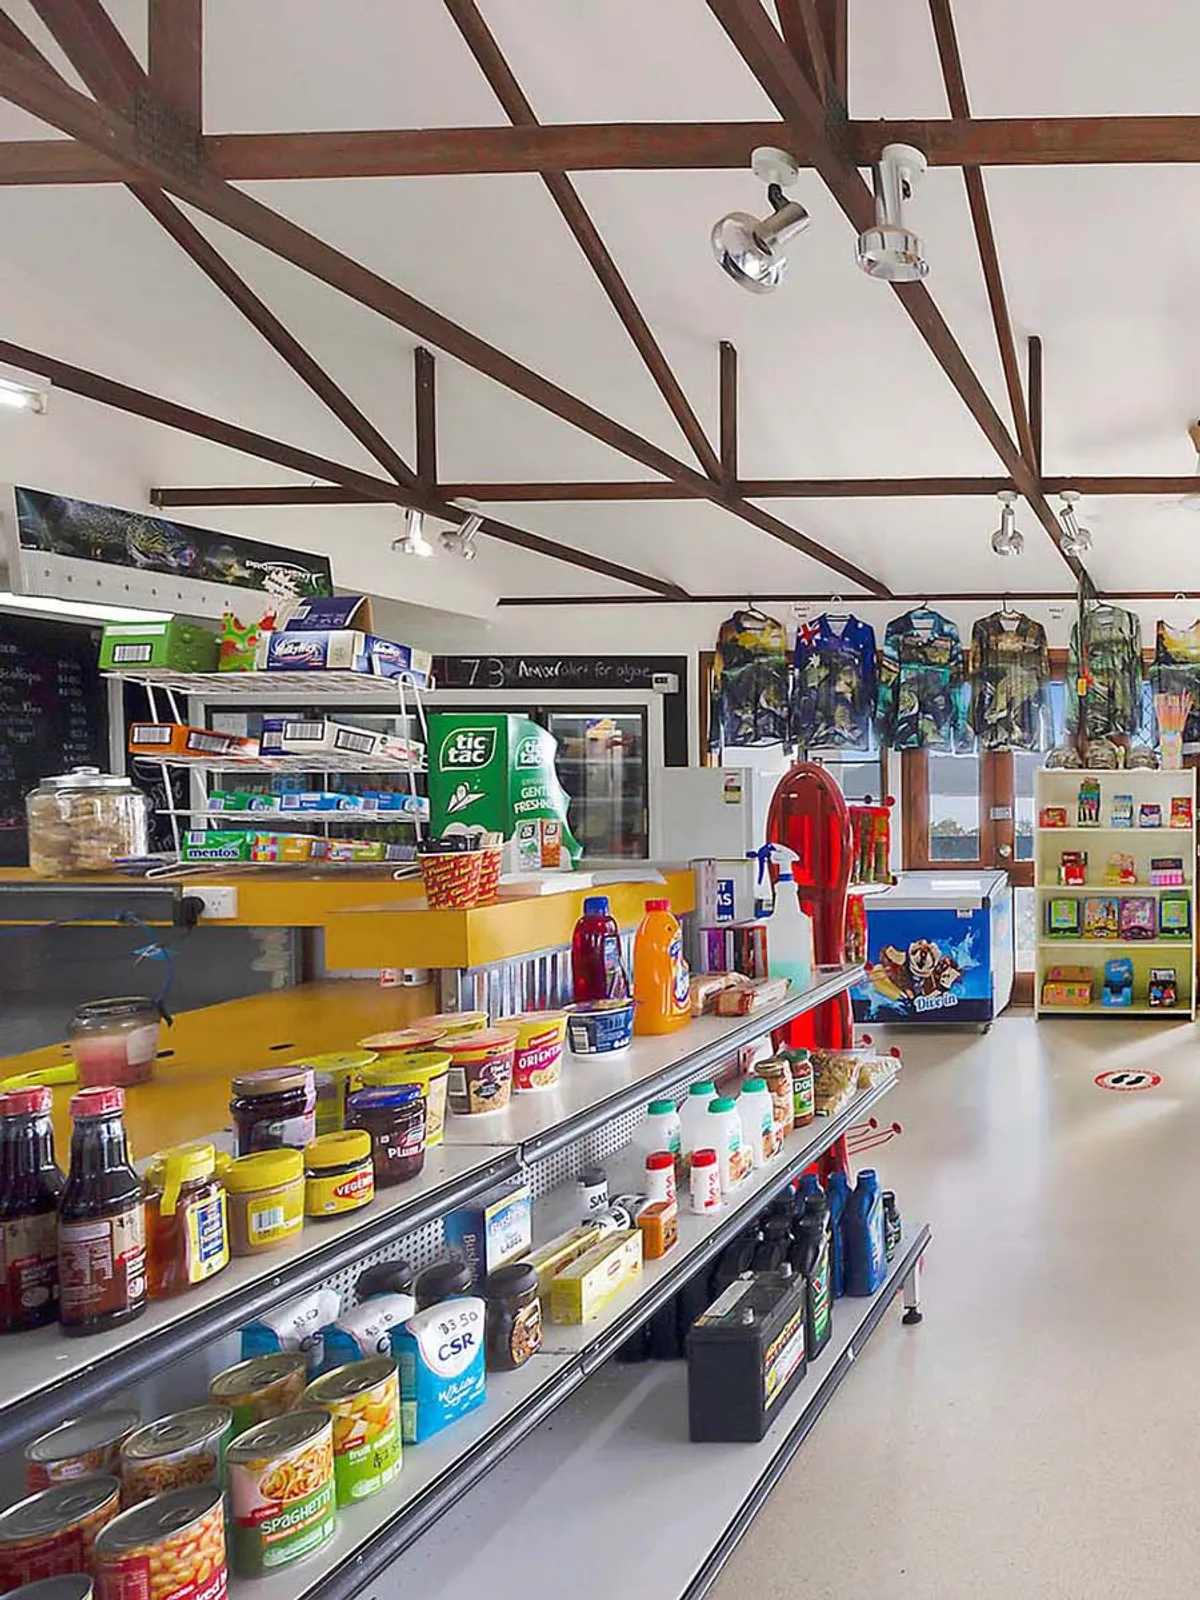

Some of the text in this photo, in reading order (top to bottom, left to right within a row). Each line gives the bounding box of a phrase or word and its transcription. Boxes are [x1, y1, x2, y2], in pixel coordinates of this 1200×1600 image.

[457, 733, 487, 750] tic
[448, 748, 485, 763] tac
[188, 848, 239, 858] mentos
[916, 997, 942, 1010] Dive
[438, 1332, 475, 1361] CSR
